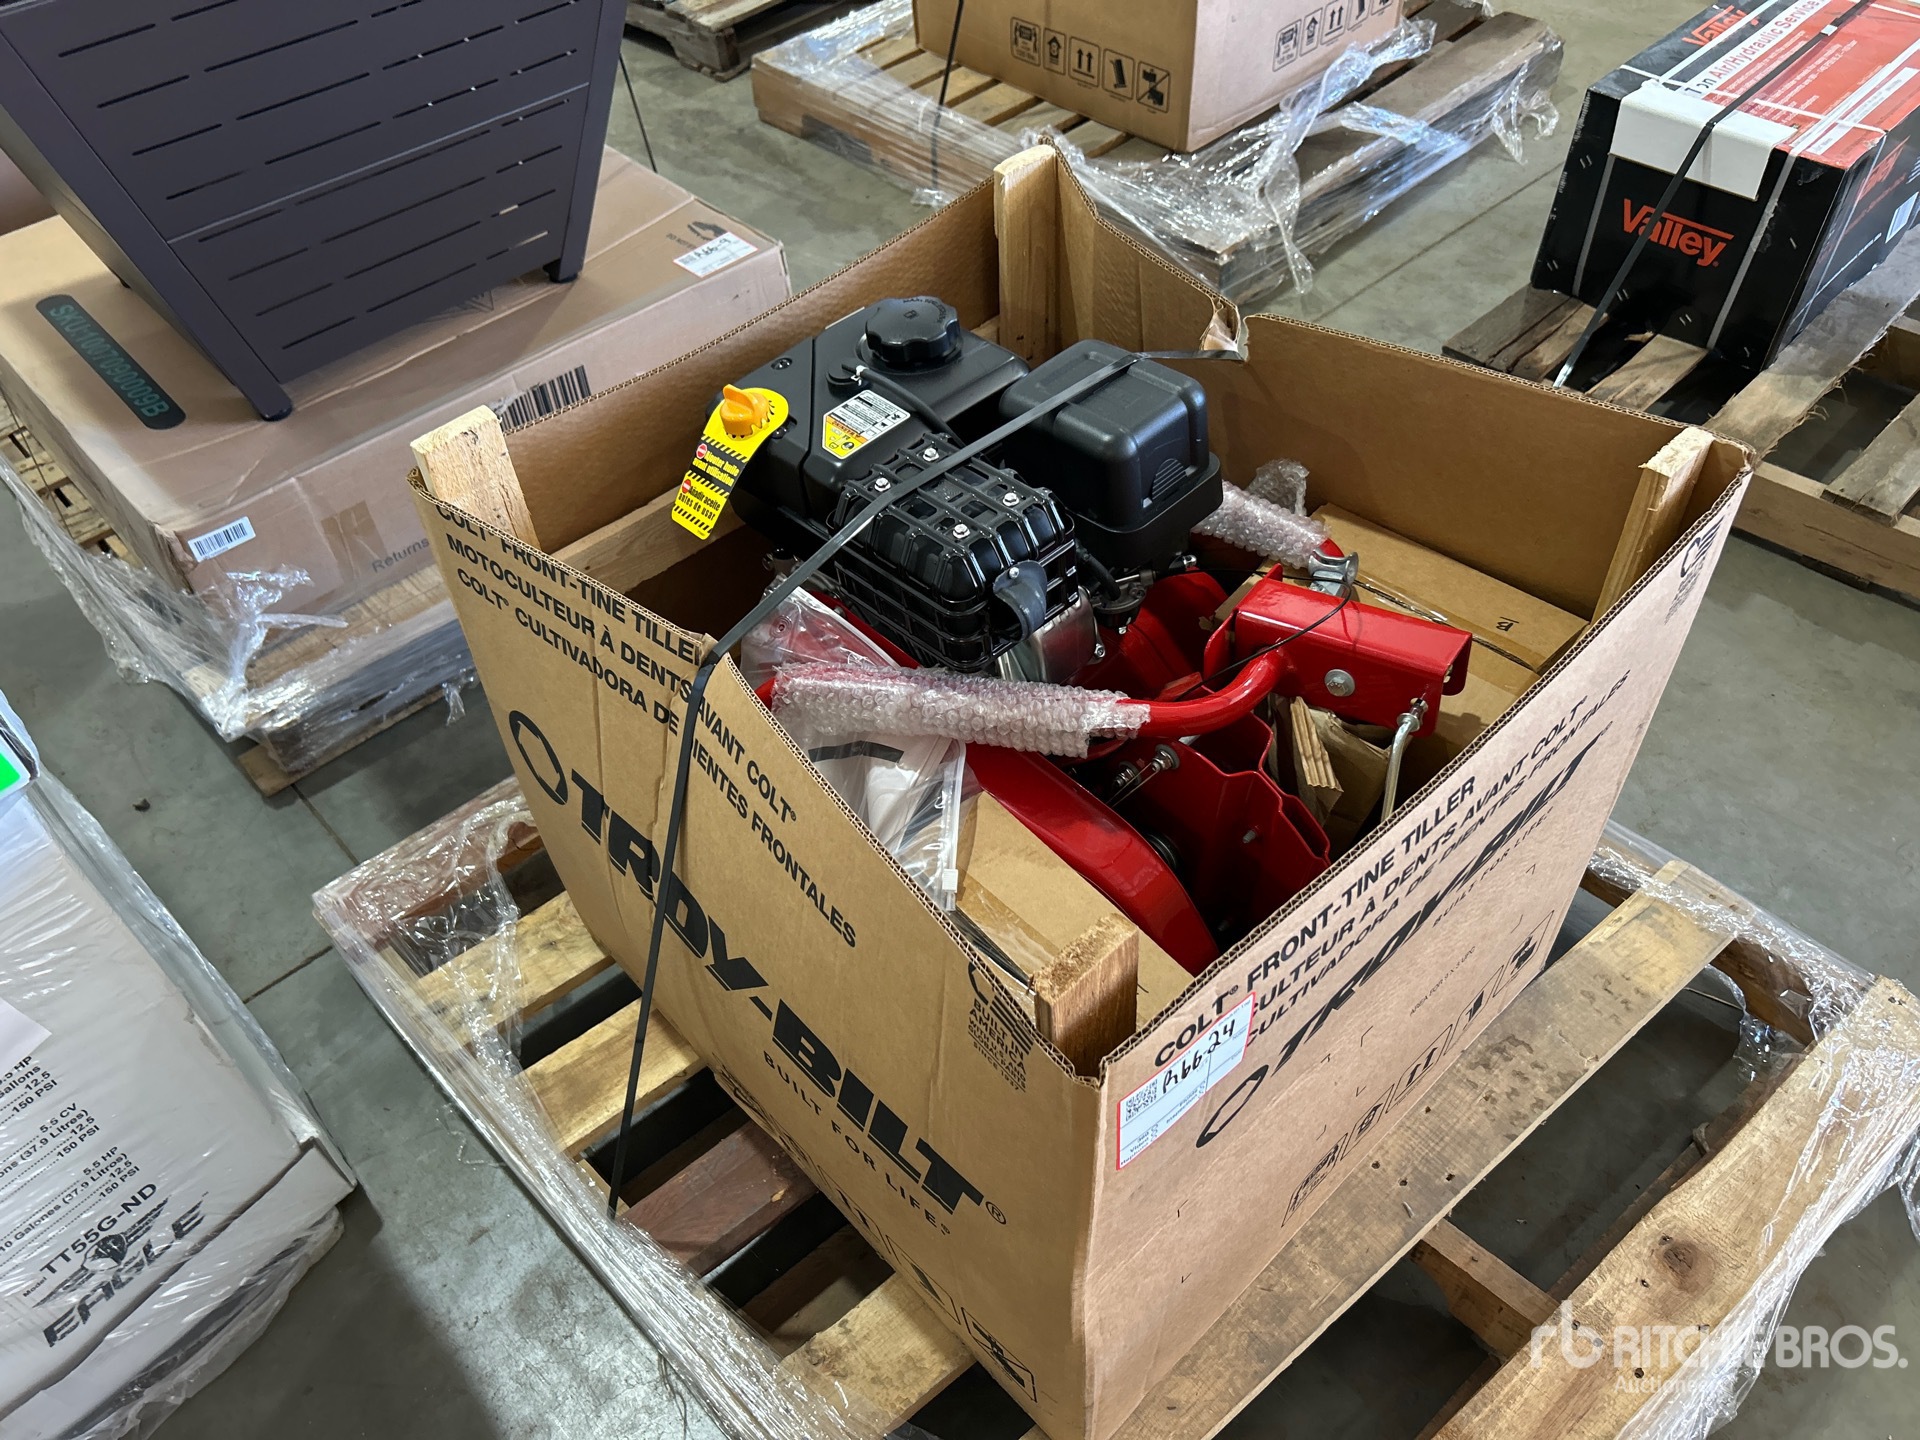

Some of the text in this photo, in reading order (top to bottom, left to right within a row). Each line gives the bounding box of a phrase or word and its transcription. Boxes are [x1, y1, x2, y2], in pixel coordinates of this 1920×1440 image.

[1709, 29, 1783, 79] Air/Hydraulic
[1775, 0, 1820, 29] Service
[1623, 198, 1735, 267] Valley
[701, 506, 716, 521] usar
[371, 537, 431, 573] Returns
[501, 538, 626, 624] FRONT-TINE
[446, 533, 595, 638] MOTOCULTEUR
[600, 624, 615, 654] À
[620, 640, 694, 703] DENTS
[697, 696, 745, 765] AVANT
[514, 607, 648, 713] CULTIVADORA
[653, 700, 680, 736] DE
[691, 740, 748, 820] IENTES
[751, 811, 857, 948] FRONTALES
[1405, 858, 1438, 898] DE
[1440, 775, 1527, 861] DIENTES
[1529, 669, 1631, 779] FRONTALES
[1383, 821, 1458, 902] DENTS
[1460, 752, 1530, 829] AVANT
[1247, 847, 1396, 993] FRONT-TINE
[1402, 776, 1476, 856] TILLER
[968, 1025, 1002, 1064] GLOBAL
[969, 1009, 1027, 1075] AMERICA
[969, 1016, 990, 1043] WITH
[1007, 1060, 1027, 1082] AND
[973, 998, 1025, 1061] BUILT IN
[14, 1056, 32, 1071] HP
[25, 1070, 51, 1091] 12.5
[12, 1079, 58, 1114] 150 PSI
[40, 1102, 77, 1133] 5.5 CV
[70, 1116, 95, 1136] 12.5
[763, 1050, 822, 1117] BUILT
[831, 1119, 876, 1172] FOR
[20, 1137, 49, 1161] (37.9
[56, 1124, 100, 1159] 150 PSI
[83, 1146, 118, 1176] 5.5 HP
[109, 1160, 133, 1179] 12.5
[14, 1204, 61, 1242] Galones
[62, 1180, 90, 1204] (37.9
[90, 1152, 128, 1182] Litros)
[99, 1166, 140, 1199] 150 PSI
[22, 1183, 157, 1297] Model TT55G-ND
[43, 1199, 206, 1347] EAGLE
